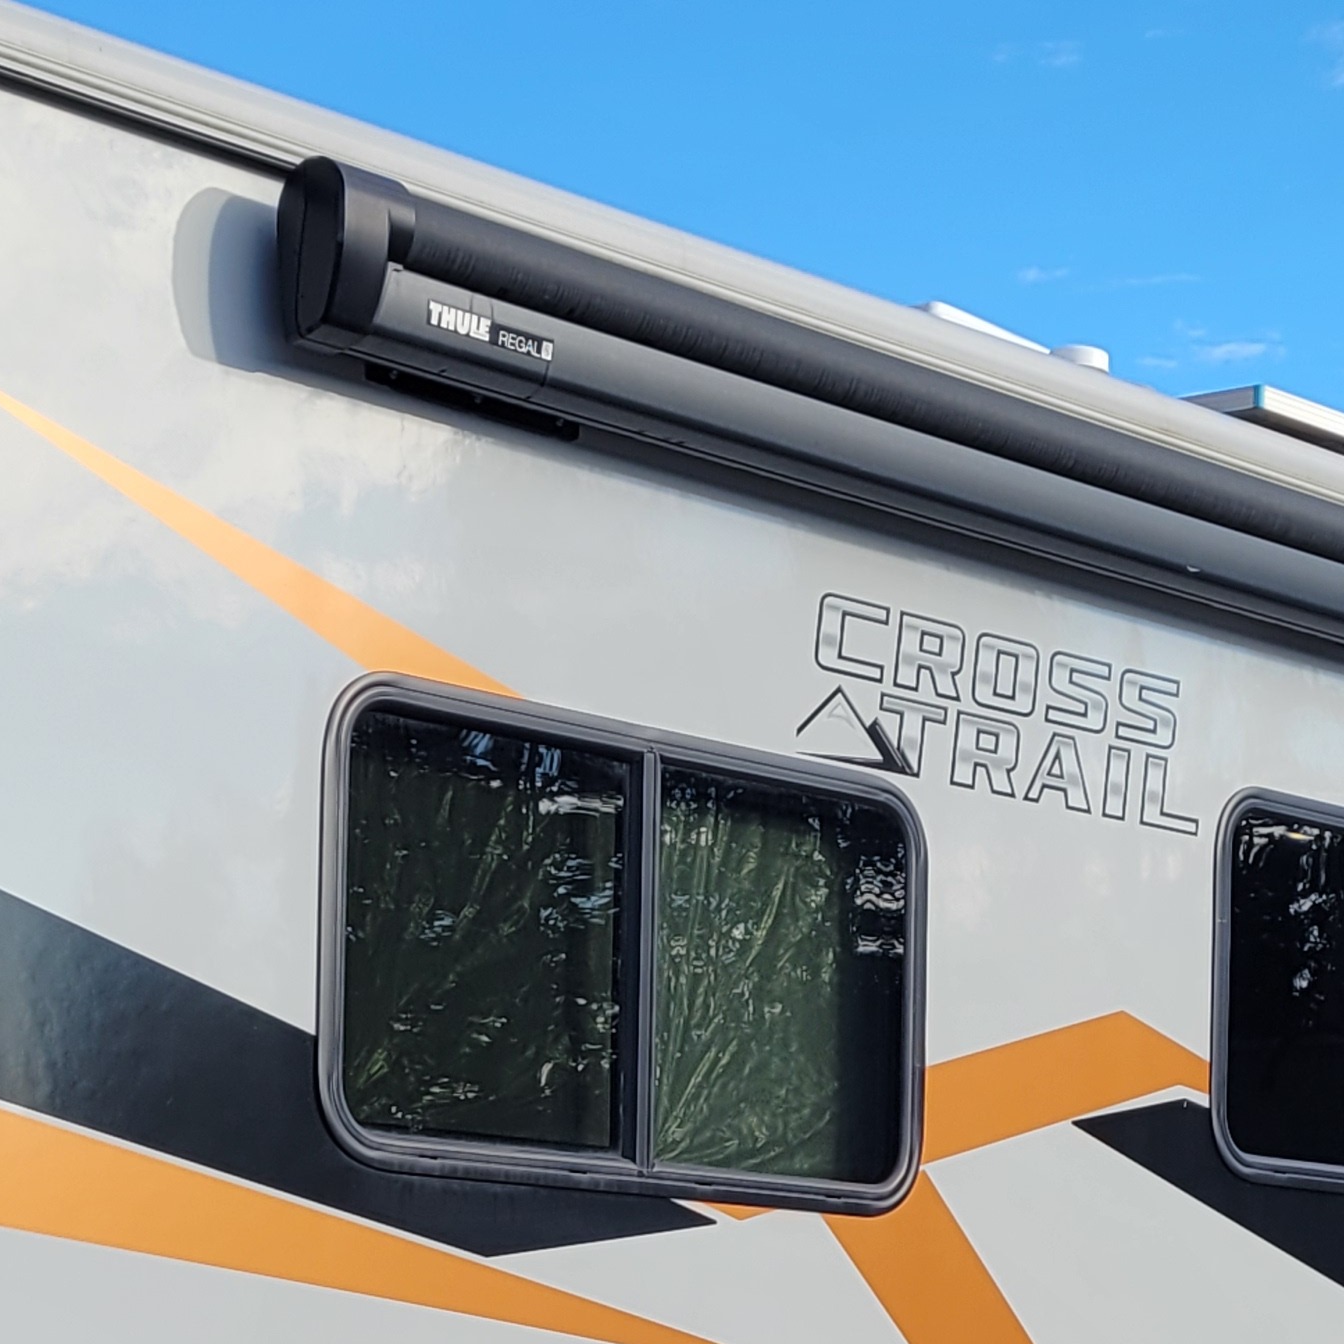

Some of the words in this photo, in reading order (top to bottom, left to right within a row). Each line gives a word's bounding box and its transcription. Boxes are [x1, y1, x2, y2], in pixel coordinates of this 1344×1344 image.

[428, 299, 492, 342] THULE
[497, 330, 542, 359] REGAL
[814, 591, 1182, 751] CROSS
[879, 691, 1200, 837] TRAIL
